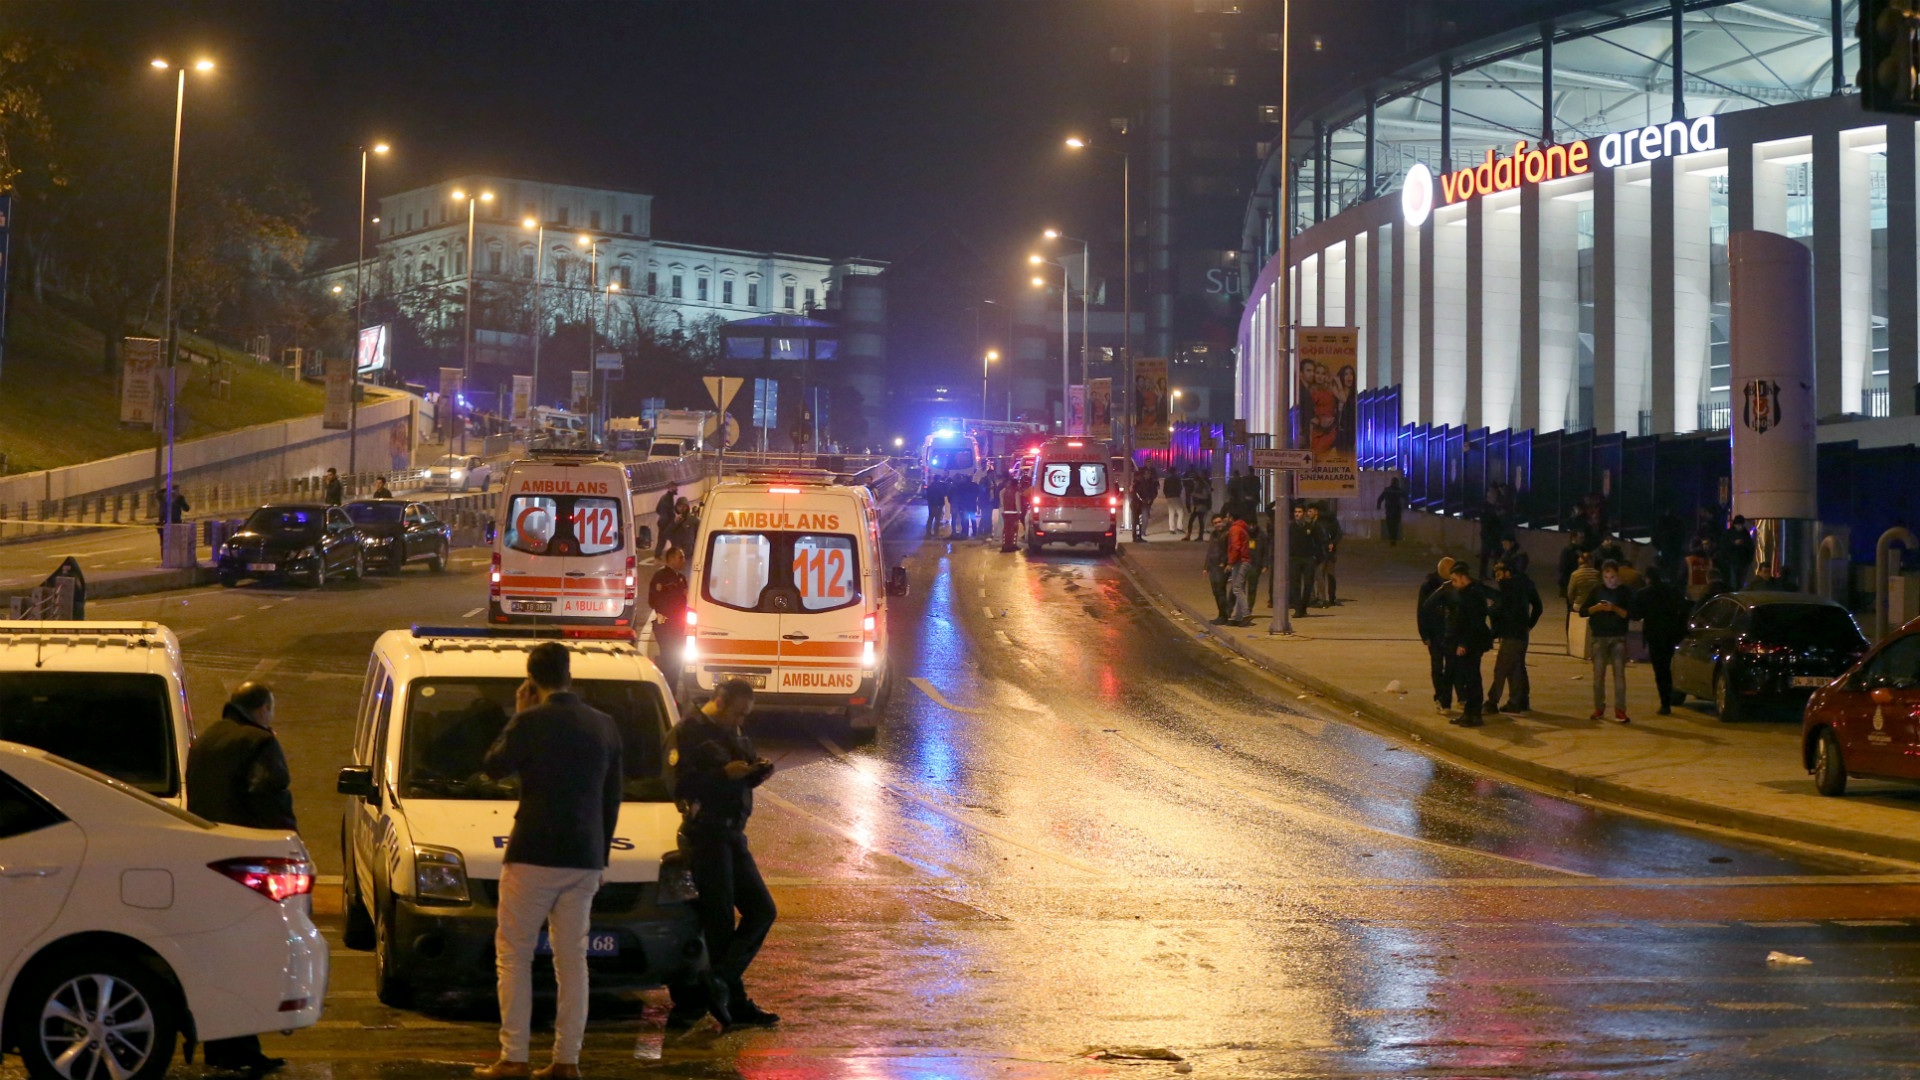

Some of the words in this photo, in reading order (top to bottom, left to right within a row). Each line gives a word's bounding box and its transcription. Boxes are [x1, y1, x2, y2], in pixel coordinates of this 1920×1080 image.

[1440, 140, 1589, 205] vodafone
[1598, 115, 1717, 168] arena
[520, 480, 608, 494] AMBULANS
[1053, 474, 1066, 483] 112
[573, 508, 613, 545] 112
[723, 512, 840, 530] AMBULANS
[792, 548, 845, 598] 112
[782, 672, 854, 688] AMBULANS
